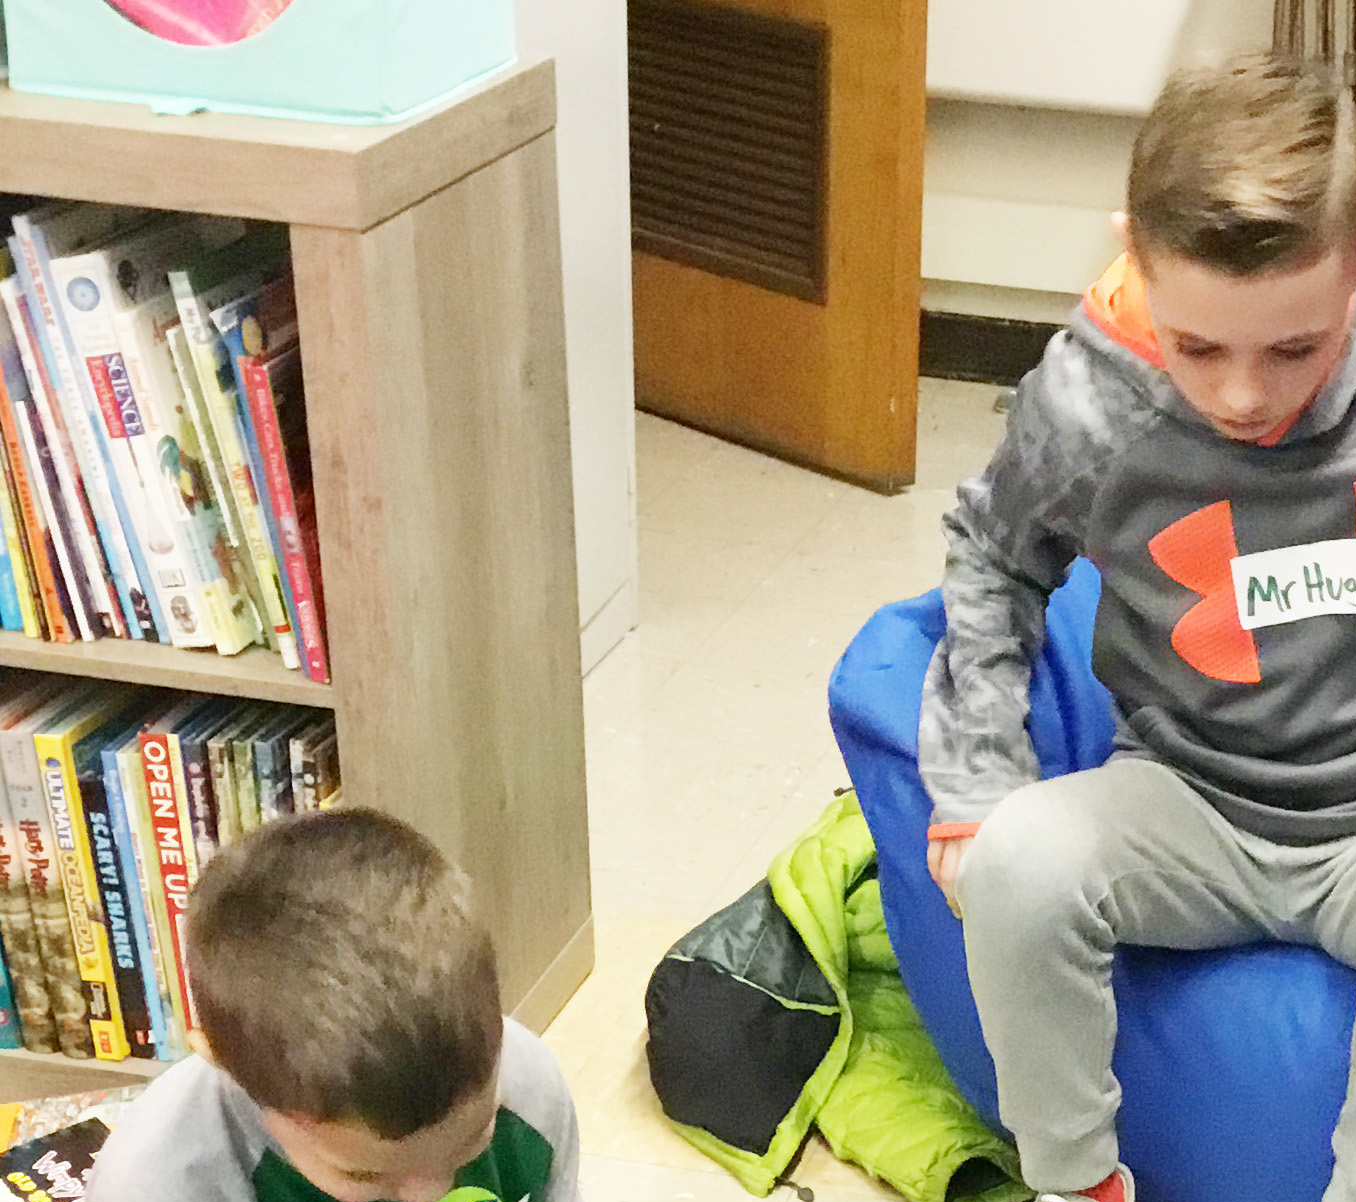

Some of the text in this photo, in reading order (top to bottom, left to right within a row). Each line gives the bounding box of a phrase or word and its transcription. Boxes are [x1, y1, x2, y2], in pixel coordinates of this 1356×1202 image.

[102, 354, 144, 435] SCIENCE
[1247, 575, 1297, 616] Mr
[143, 740, 177, 819] OPEN
[46, 771, 95, 955] ULTIMATE OCEANPEDIA
[156, 826, 183, 867] ME
[88, 811, 120, 886] SCARY!
[104, 890, 135, 969] SHARKS
[164, 873, 189, 911] UP
